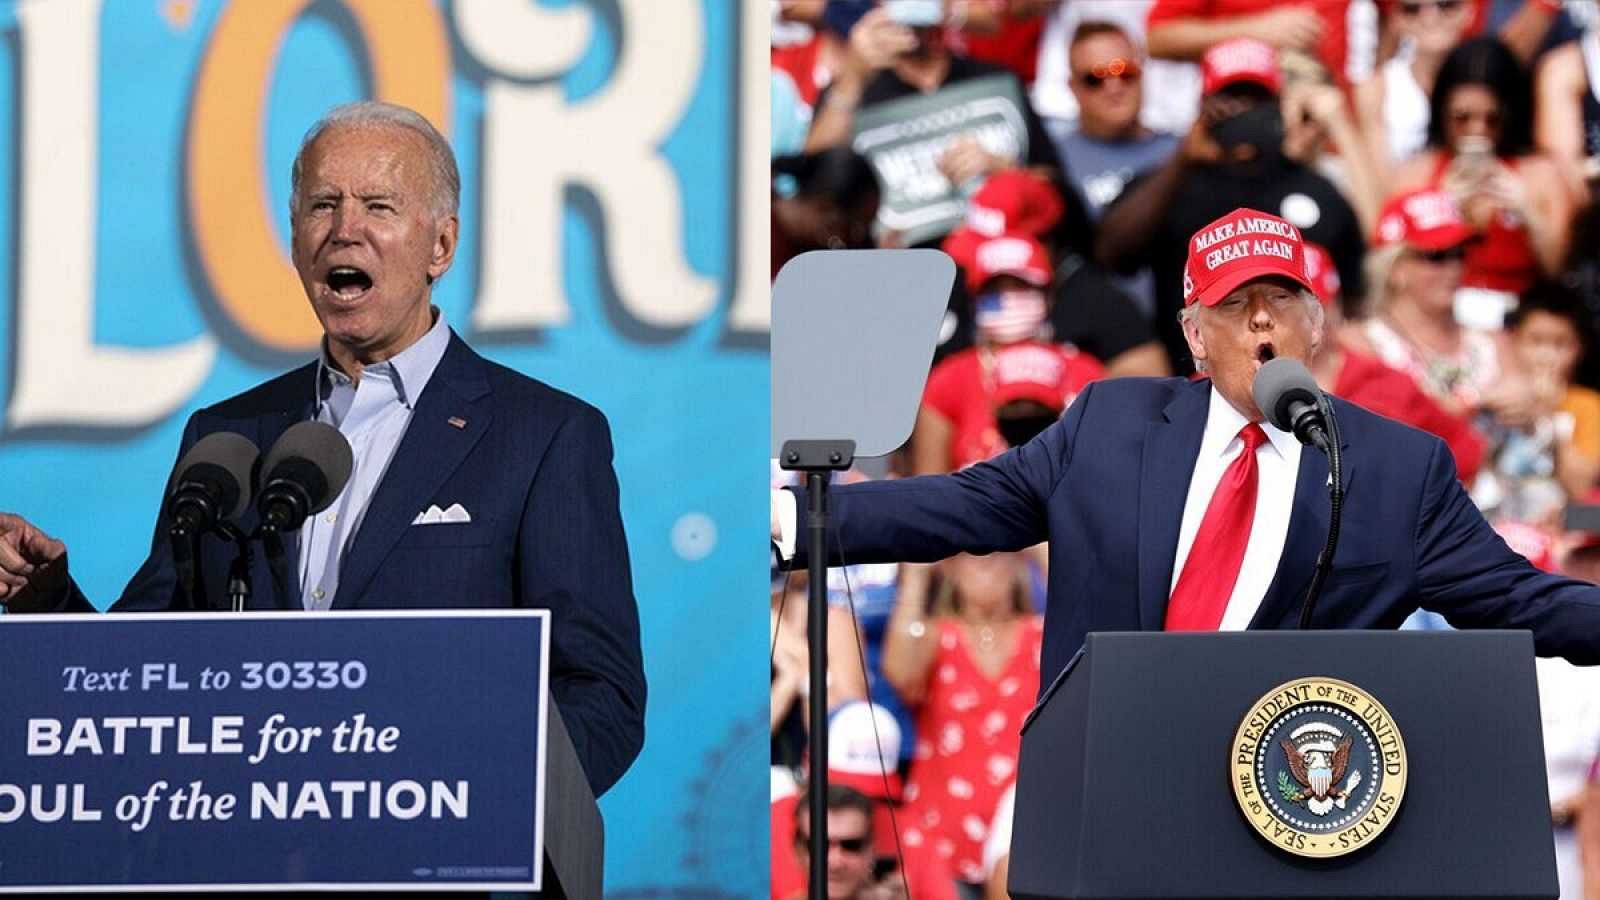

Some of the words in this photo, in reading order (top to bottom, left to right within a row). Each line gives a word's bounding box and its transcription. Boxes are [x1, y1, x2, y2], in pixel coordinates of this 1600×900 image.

[1195, 223, 1234, 252] MAKE
[1237, 219, 1297, 241] AMERICA
[1206, 241, 1249, 269] GREAT
[1253, 240, 1293, 260] AGAIN
[62, 666, 131, 692] Text
[141, 664, 189, 691] FL
[199, 666, 231, 691] to
[240, 661, 368, 690] 30330
[1316, 686, 1332, 697] OF
[1336, 689, 1359, 707] THE
[27, 715, 244, 756] BATTLE
[248, 713, 322, 765] for
[331, 713, 401, 753] the
[1238, 685, 1311, 766] PRESIDENT
[1362, 704, 1401, 776] UNITED
[1240, 772, 1254, 797] THE
[115, 780, 168, 832] of
[169, 780, 237, 821] the
[250, 780, 469, 820] NATION
[1247, 801, 1262, 815] OF
[1338, 792, 1395, 849] STATES
[1260, 814, 1308, 850] SEAL
